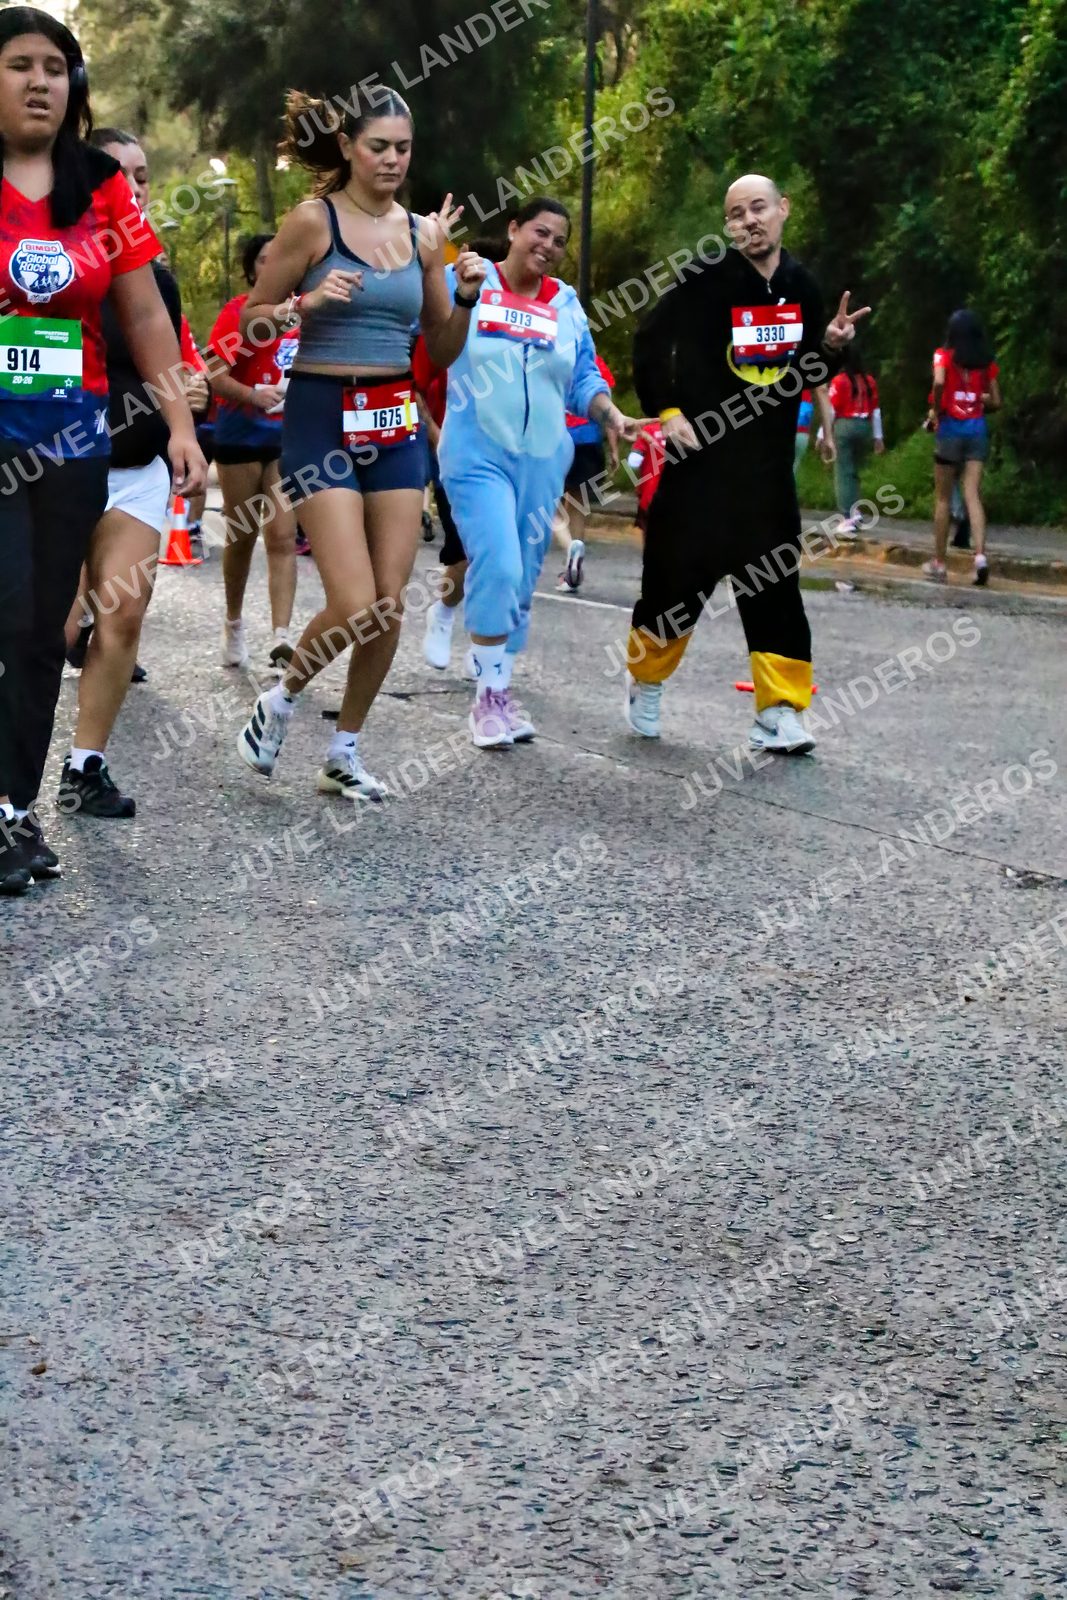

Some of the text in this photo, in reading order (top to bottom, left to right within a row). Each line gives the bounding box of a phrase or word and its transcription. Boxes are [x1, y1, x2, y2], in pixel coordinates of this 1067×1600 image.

[25, 244, 58, 253] BIMBO
[19, 261, 47, 273] Race
[26, 253, 58, 265] Global
[504, 309, 533, 327] 1913
[756, 325, 786, 343] 3330
[7, 347, 41, 372] 914
[372, 407, 402, 429] 1675
